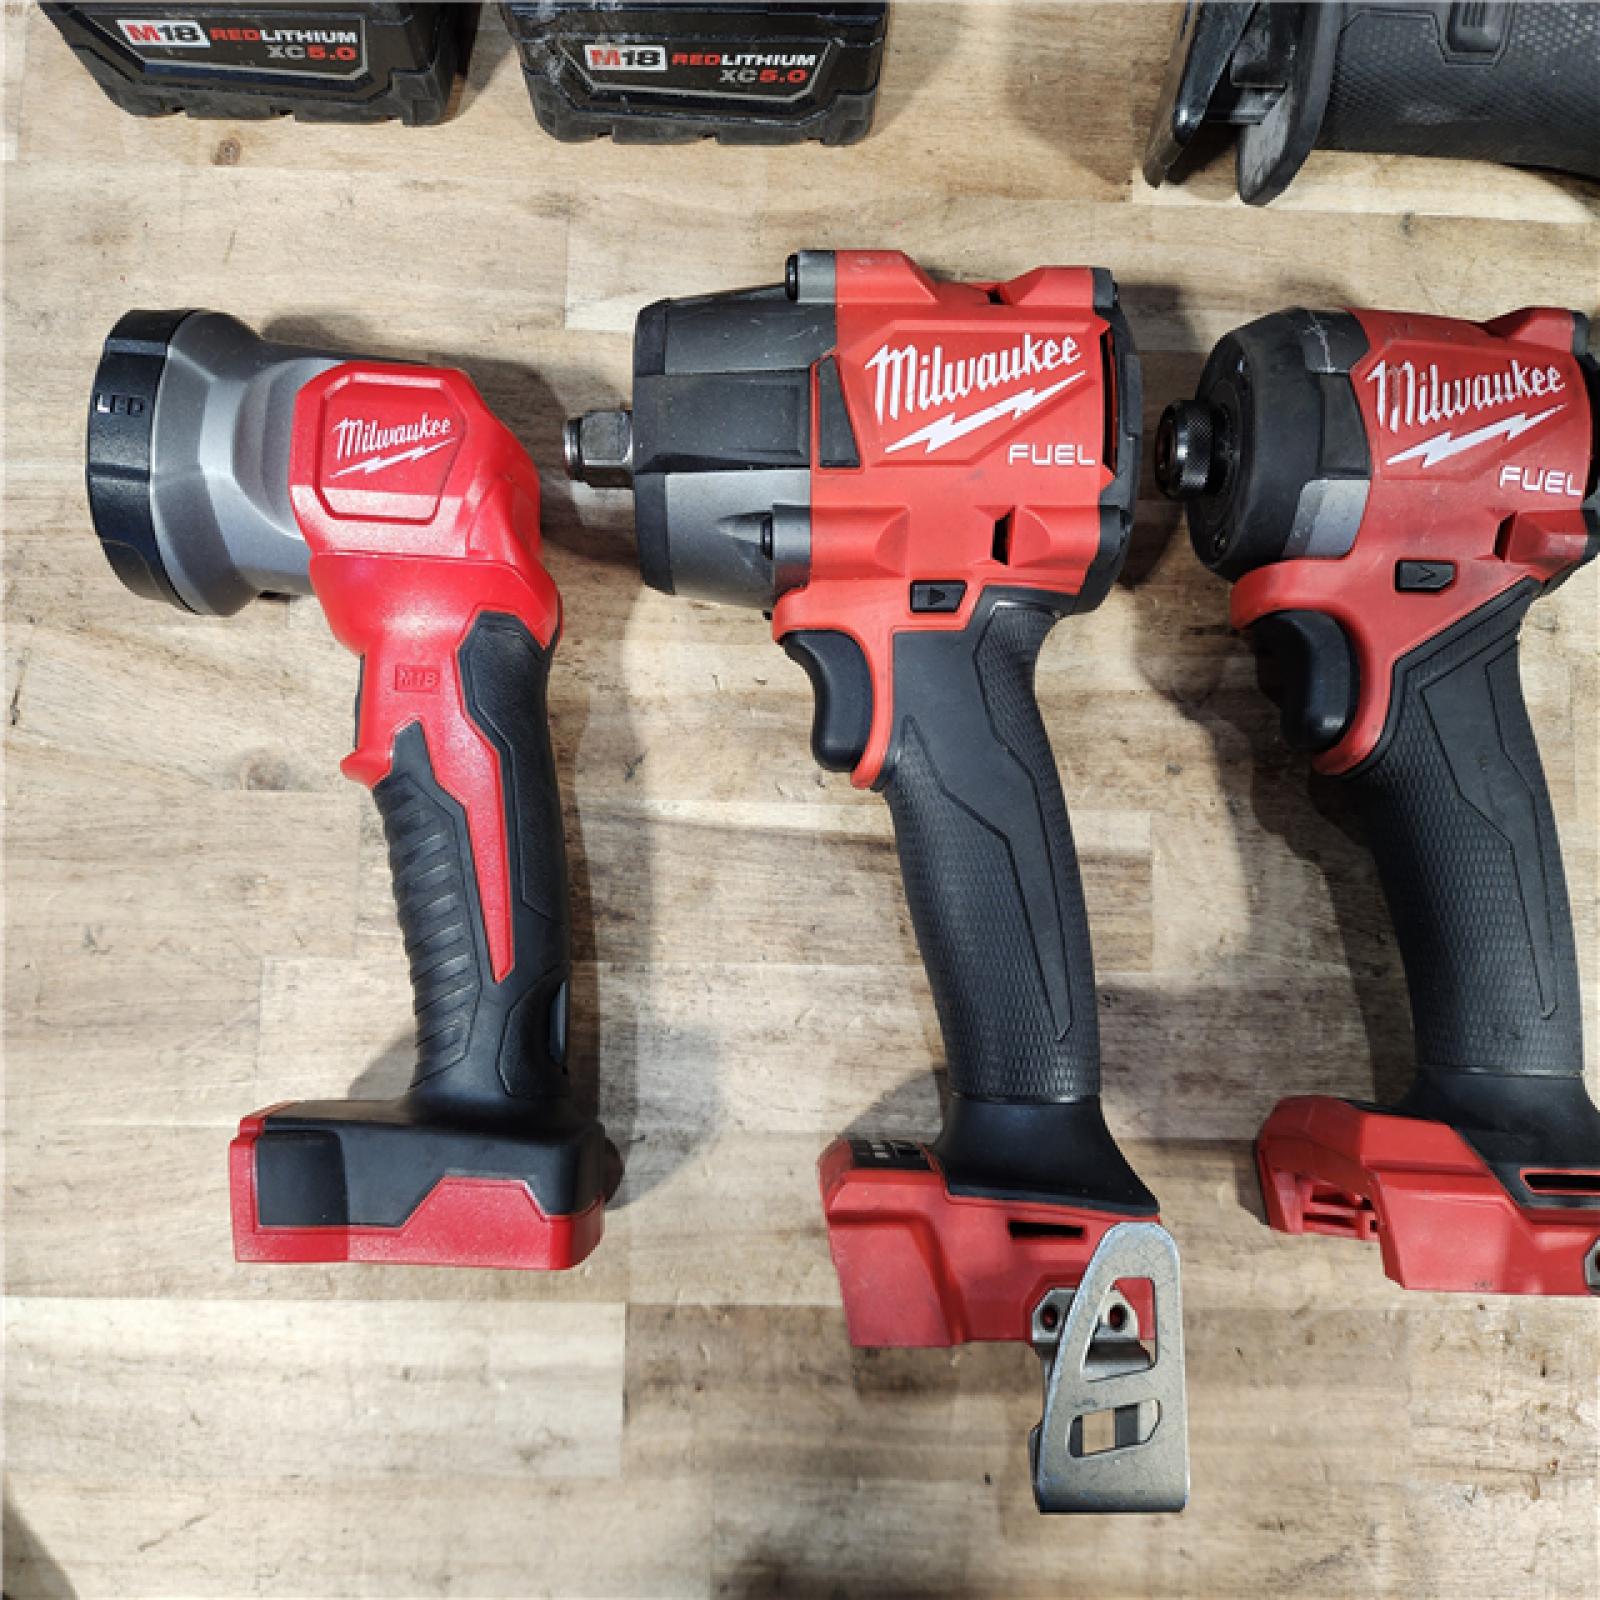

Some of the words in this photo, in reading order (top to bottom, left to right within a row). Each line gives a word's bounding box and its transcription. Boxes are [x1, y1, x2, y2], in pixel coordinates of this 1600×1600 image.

[125, 24, 198, 43] M18
[209, 28, 357, 44] REDLITHIUM
[267, 44, 356, 61] XC5.0
[591, 49, 660, 67] M18
[671, 54, 816, 66] REDLITHIUM
[719, 68, 808, 83] XC5.0
[865, 333, 1081, 425] Milwaukee
[95, 393, 144, 417] LED
[1367, 359, 1566, 433] Milwaukee
[331, 412, 452, 460] Milwaukee
[1008, 442, 1096, 466] FUEL
[1499, 464, 1583, 496] FUEL
